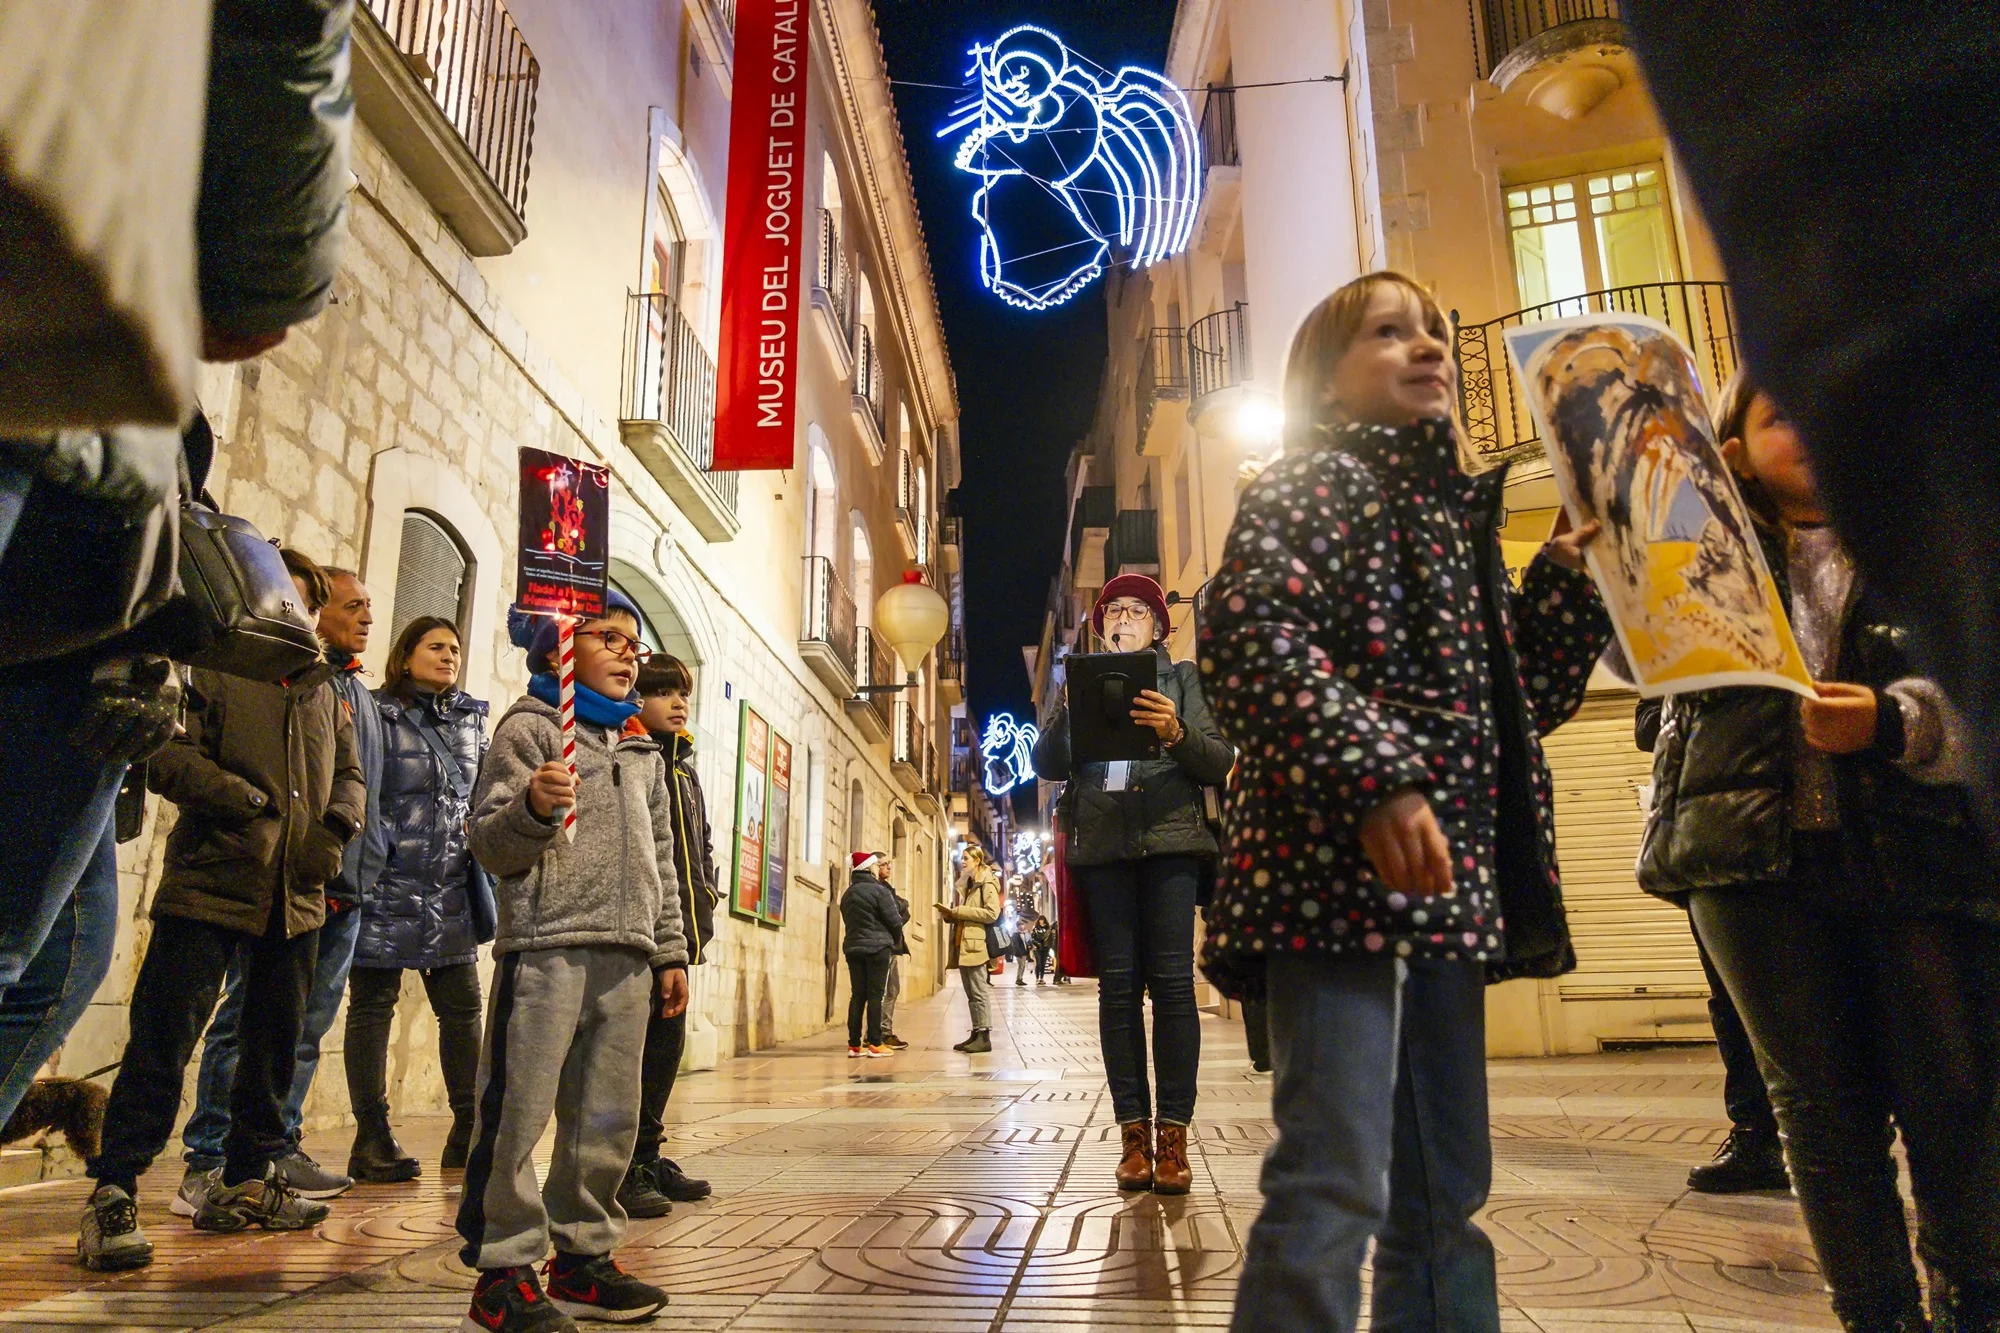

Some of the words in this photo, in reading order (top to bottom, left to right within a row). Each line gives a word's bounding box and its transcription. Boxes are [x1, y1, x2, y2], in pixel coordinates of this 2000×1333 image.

[772, 0, 798, 83] CATAL
[770, 92, 795, 127] DE
[765, 136, 793, 247] JOGUET
[761, 255, 789, 312] DEL
[756, 319, 786, 428] MUSEU
